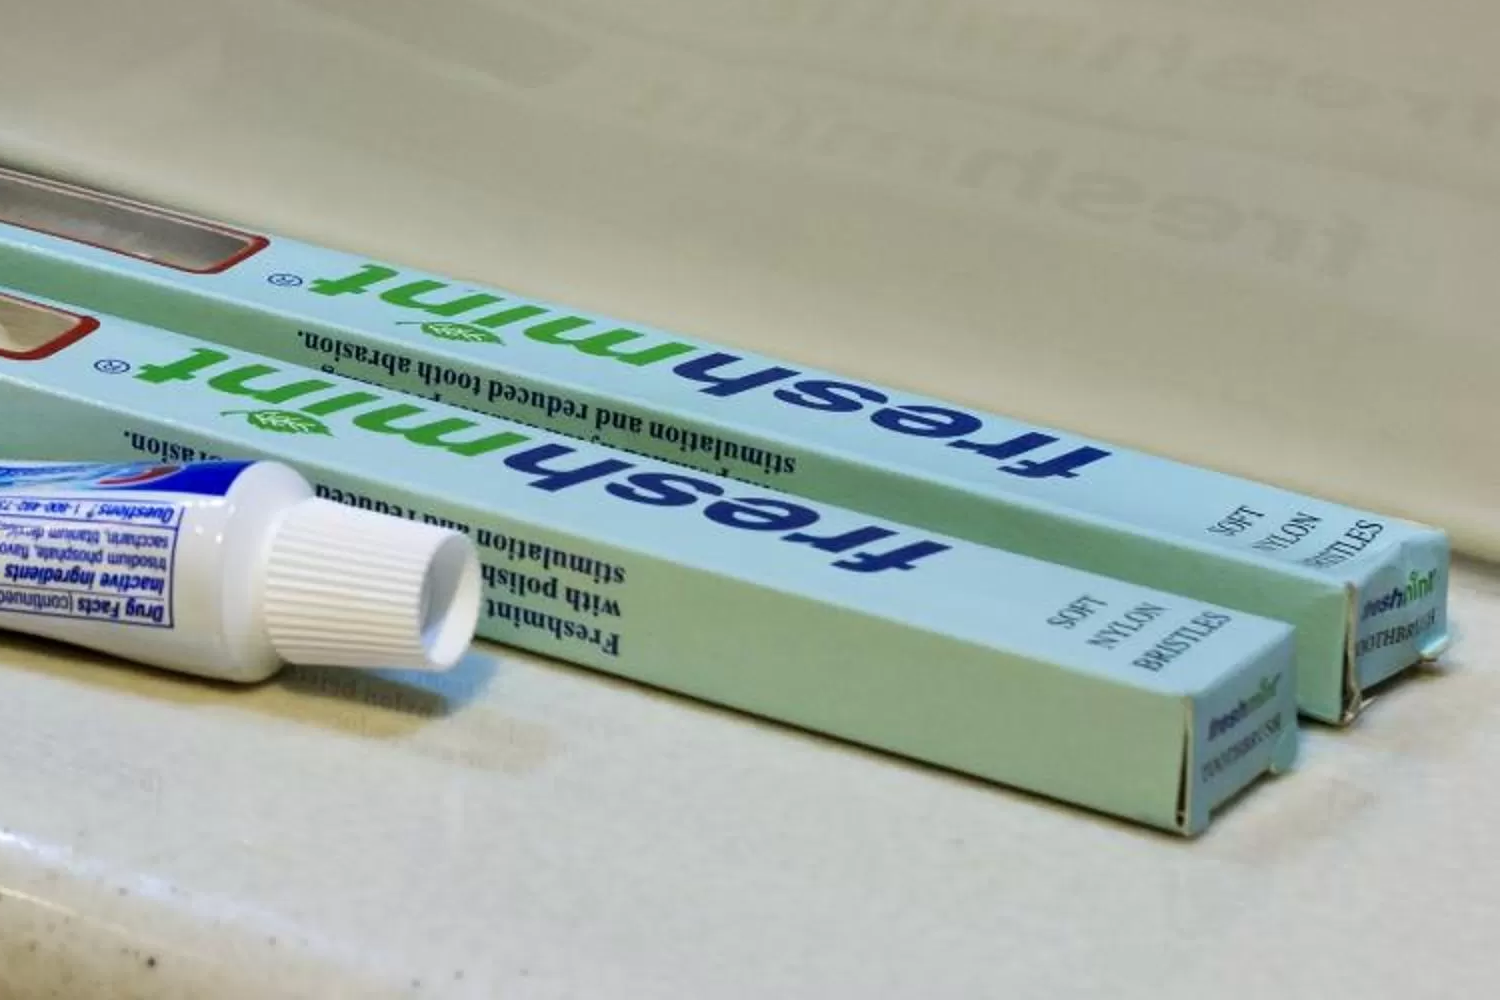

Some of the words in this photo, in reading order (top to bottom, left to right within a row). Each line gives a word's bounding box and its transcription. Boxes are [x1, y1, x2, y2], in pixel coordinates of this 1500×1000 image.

[297, 329, 410, 377] abrasion.
[307, 263, 1111, 478] freshmint
[417, 362, 480, 396] tooth
[487, 379, 588, 419] reduced
[594, 407, 641, 434] and
[131, 347, 952, 573] freshmint
[649, 420, 796, 475] stimulation
[86, 503, 174, 523] Questions?
[1205, 504, 1264, 536] SOFT
[47, 528, 100, 544] titanium
[107, 554, 166, 570] trisodium
[476, 528, 624, 585] stimulation
[4, 565, 94, 590] ingredients
[100, 573, 164, 594] Inactive
[78, 599, 119, 618] Facts
[125, 598, 163, 622] Drug
[564, 587, 620, 619] with
[1046, 593, 1107, 629] SOFT
[485, 598, 620, 656] Freshmint
[1086, 601, 1170, 650] NYLON
[1132, 610, 1232, 672] BRISTLES
